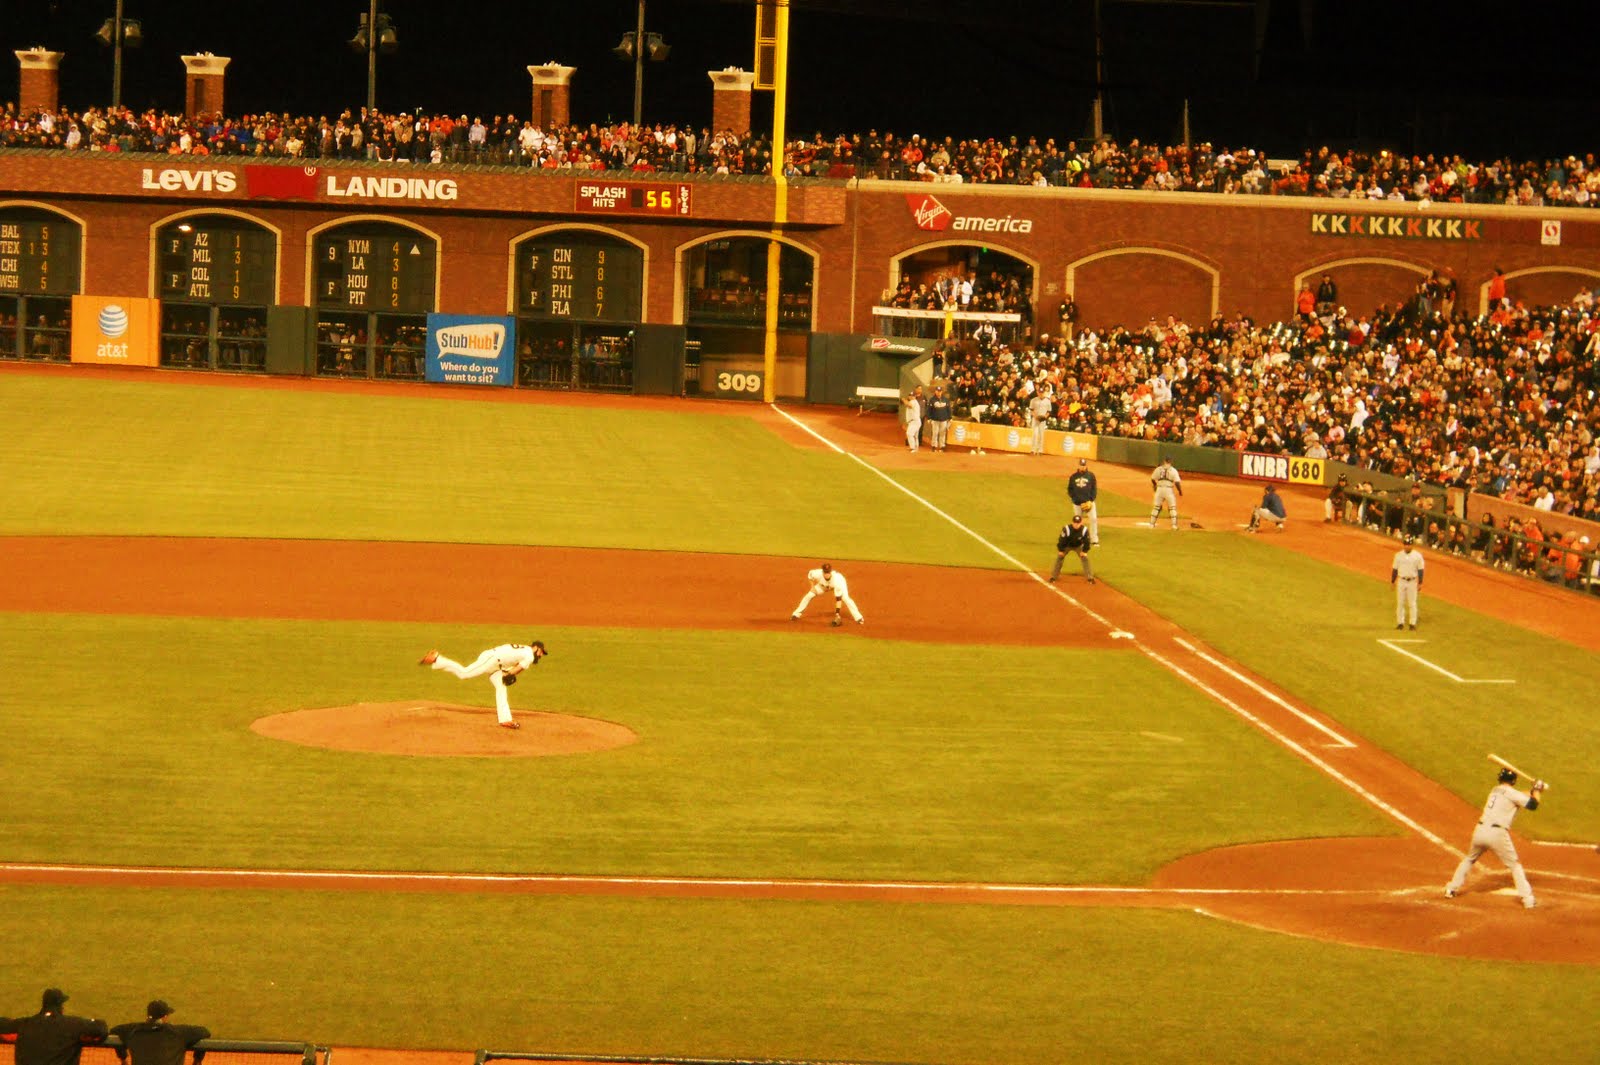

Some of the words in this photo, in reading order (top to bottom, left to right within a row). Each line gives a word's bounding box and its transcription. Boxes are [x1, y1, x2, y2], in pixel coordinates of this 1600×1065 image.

[327, 176, 457, 200] LANDING
[581, 186, 626, 198] SPLASH
[592, 198, 615, 208] HITS
[646, 191, 672, 208] 56
[914, 200, 945, 228] Virgin
[952, 215, 1033, 233] america
[1, 225, 20, 238] BAL
[42, 227, 48, 240] 5
[195, 233, 208, 247] AZ
[235, 235, 240, 248] 1
[0, 240, 20, 254] TEX
[30, 242, 35, 255] 1
[42, 242, 48, 256] 3
[172, 240, 179, 253] F
[329, 246, 336, 260] 9
[348, 239, 370, 254] NYM
[392, 241, 399, 255] 4
[192, 249, 211, 263] MIL
[235, 251, 241, 264] 3
[352, 256, 365, 270] LA
[392, 258, 399, 271] 3
[532, 255, 539, 269] F
[553, 248, 572, 263] CIN
[598, 250, 605, 264] 9
[1, 258, 17, 272] CHI
[41, 260, 48, 273] 4
[552, 265, 573, 279] STL
[597, 267, 604, 281] 8
[0, 274, 19, 288] WSH
[41, 276, 47, 290] 5
[172, 274, 179, 288] F
[191, 267, 210, 281] COL
[235, 270, 240, 283] 1
[347, 274, 368, 288] HOU
[391, 276, 398, 290] 8
[190, 283, 211, 297] ATL
[233, 285, 240, 299] 9
[328, 281, 335, 295] F
[552, 284, 572, 298] PHI
[597, 286, 603, 300] 6
[349, 291, 366, 304] PIT
[392, 293, 398, 307] 2
[530, 291, 538, 305] F
[552, 300, 570, 315] FLA
[596, 303, 603, 317] 7
[441, 331, 499, 350] StubHub!
[96, 342, 128, 358] at&t
[440, 361, 468, 371] Where
[469, 363, 481, 372] do
[482, 365, 499, 374] you
[444, 373, 466, 381] want
[468, 374, 477, 382] to
[478, 374, 494, 383] sit?
[718, 372, 761, 392] 309
[1242, 454, 1288, 479] KNBR
[1291, 461, 1320, 480] 680
